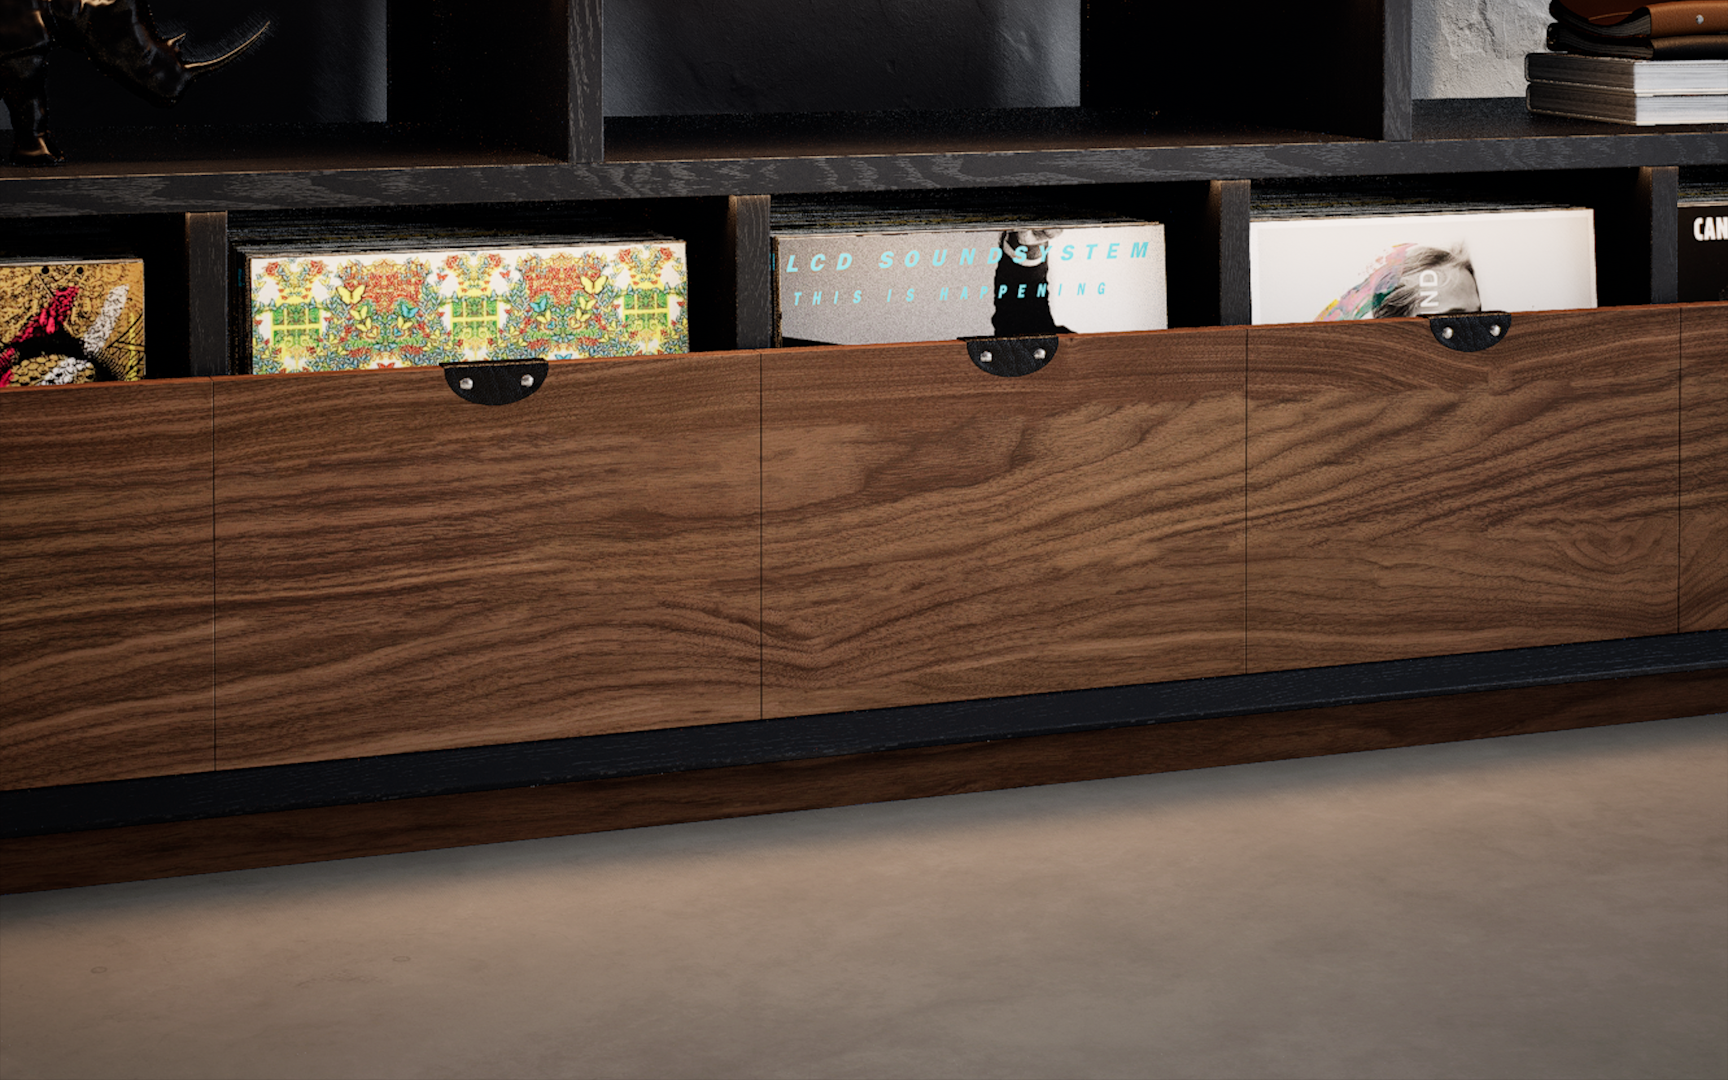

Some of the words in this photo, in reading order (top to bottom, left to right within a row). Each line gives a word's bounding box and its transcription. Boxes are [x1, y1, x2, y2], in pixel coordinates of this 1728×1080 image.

[1694, 216, 1728, 241] CAN
[786, 253, 852, 272] LCD
[794, 289, 862, 306] THIS
[886, 288, 915, 302] IS
[939, 282, 1106, 301] HAPPENING
[1420, 270, 1439, 314] ND
